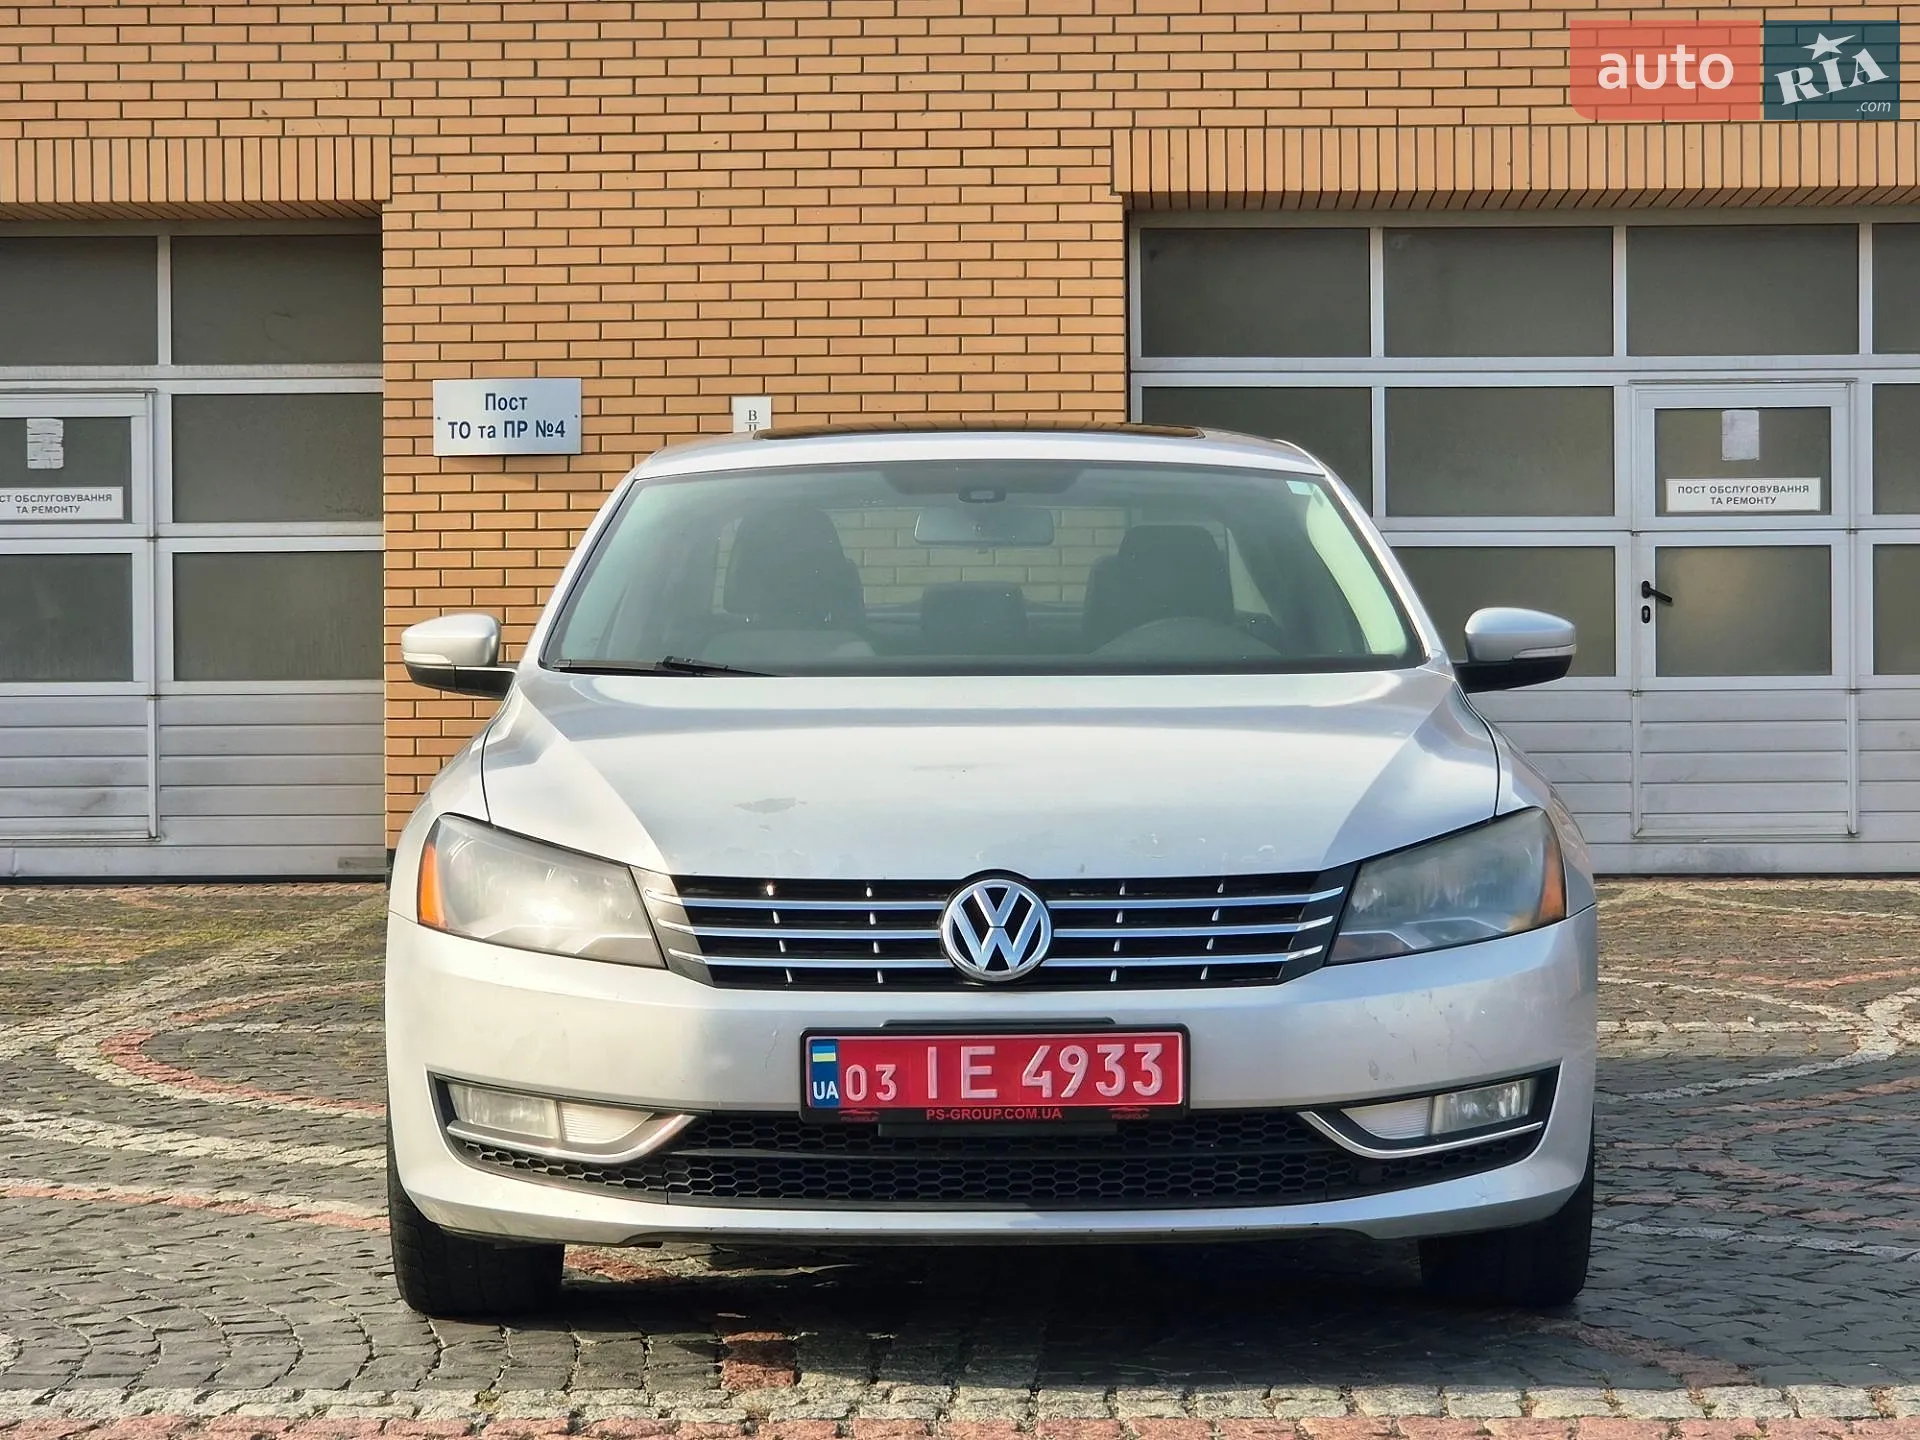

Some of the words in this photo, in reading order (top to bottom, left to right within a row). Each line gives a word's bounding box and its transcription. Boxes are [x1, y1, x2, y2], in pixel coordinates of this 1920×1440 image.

[485, 392, 528, 411] Пост
[447, 421, 471, 440] ТО
[478, 425, 496, 439] та
[504, 420, 528, 438] ПР
[535, 419, 566, 438] №4
[1677, 486, 1706, 494] ПОСТ
[1709, 484, 1810, 494] ОБСЛУГОВУВАННЯ
[14, 494, 112, 503] ОБСЛУГОВУВАННЯ
[1710, 496, 1723, 505] ТА
[1726, 496, 1777, 505] РЕМОНТУ
[16, 506, 29, 514] ТА
[31, 505, 81, 514] РЕМОНТУ
[950, 882, 1042, 974] VW
[845, 1063, 898, 1102] 03
[926, 1045, 999, 1099] IE
[1021, 1043, 1163, 1098] 4933
[812, 1080, 839, 1101] UA
[926, 1108, 1063, 1121] PS-GROUP.COM.UA
